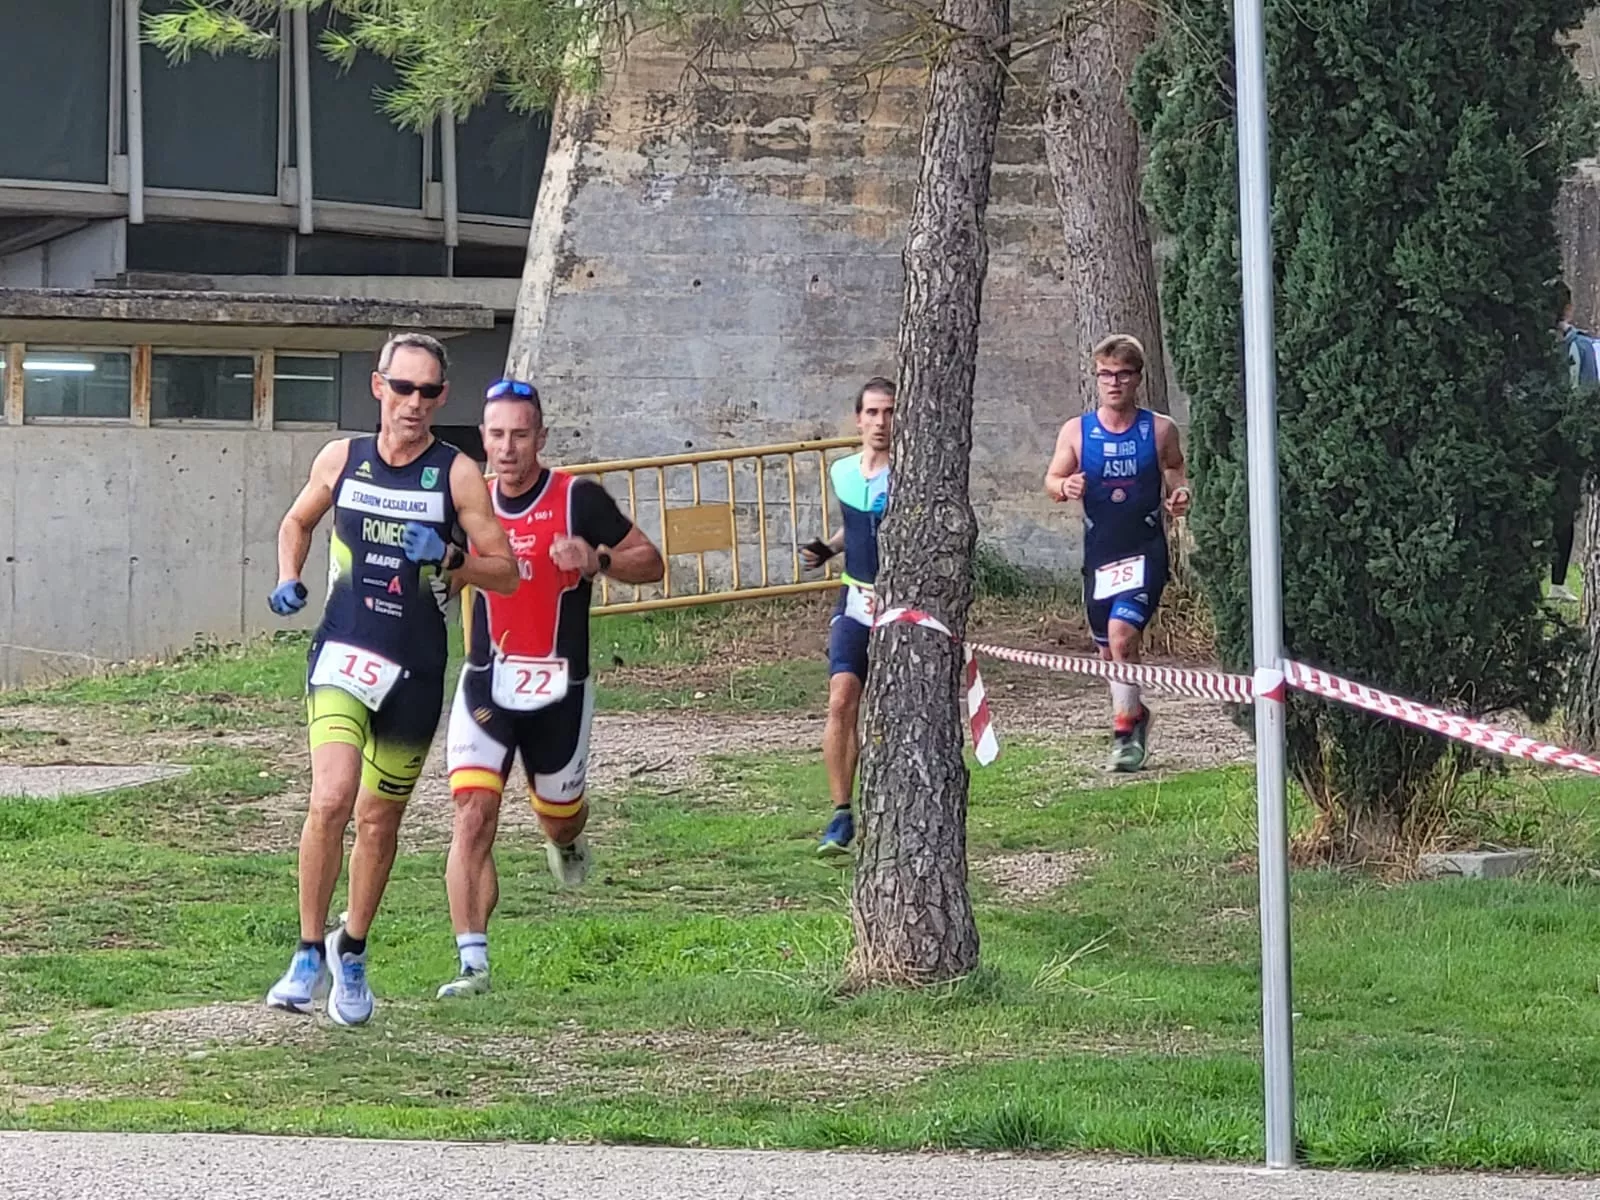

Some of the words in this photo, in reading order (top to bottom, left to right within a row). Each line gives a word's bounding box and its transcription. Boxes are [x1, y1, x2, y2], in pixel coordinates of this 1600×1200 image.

[1103, 459, 1137, 478] ASUN
[352, 490, 382, 507] STADIUM
[382, 497, 428, 513] CASABLANCA
[365, 552, 401, 569] MAPEI
[1111, 566, 1133, 587] 28
[339, 654, 382, 686] 15
[515, 669, 552, 694] 22
